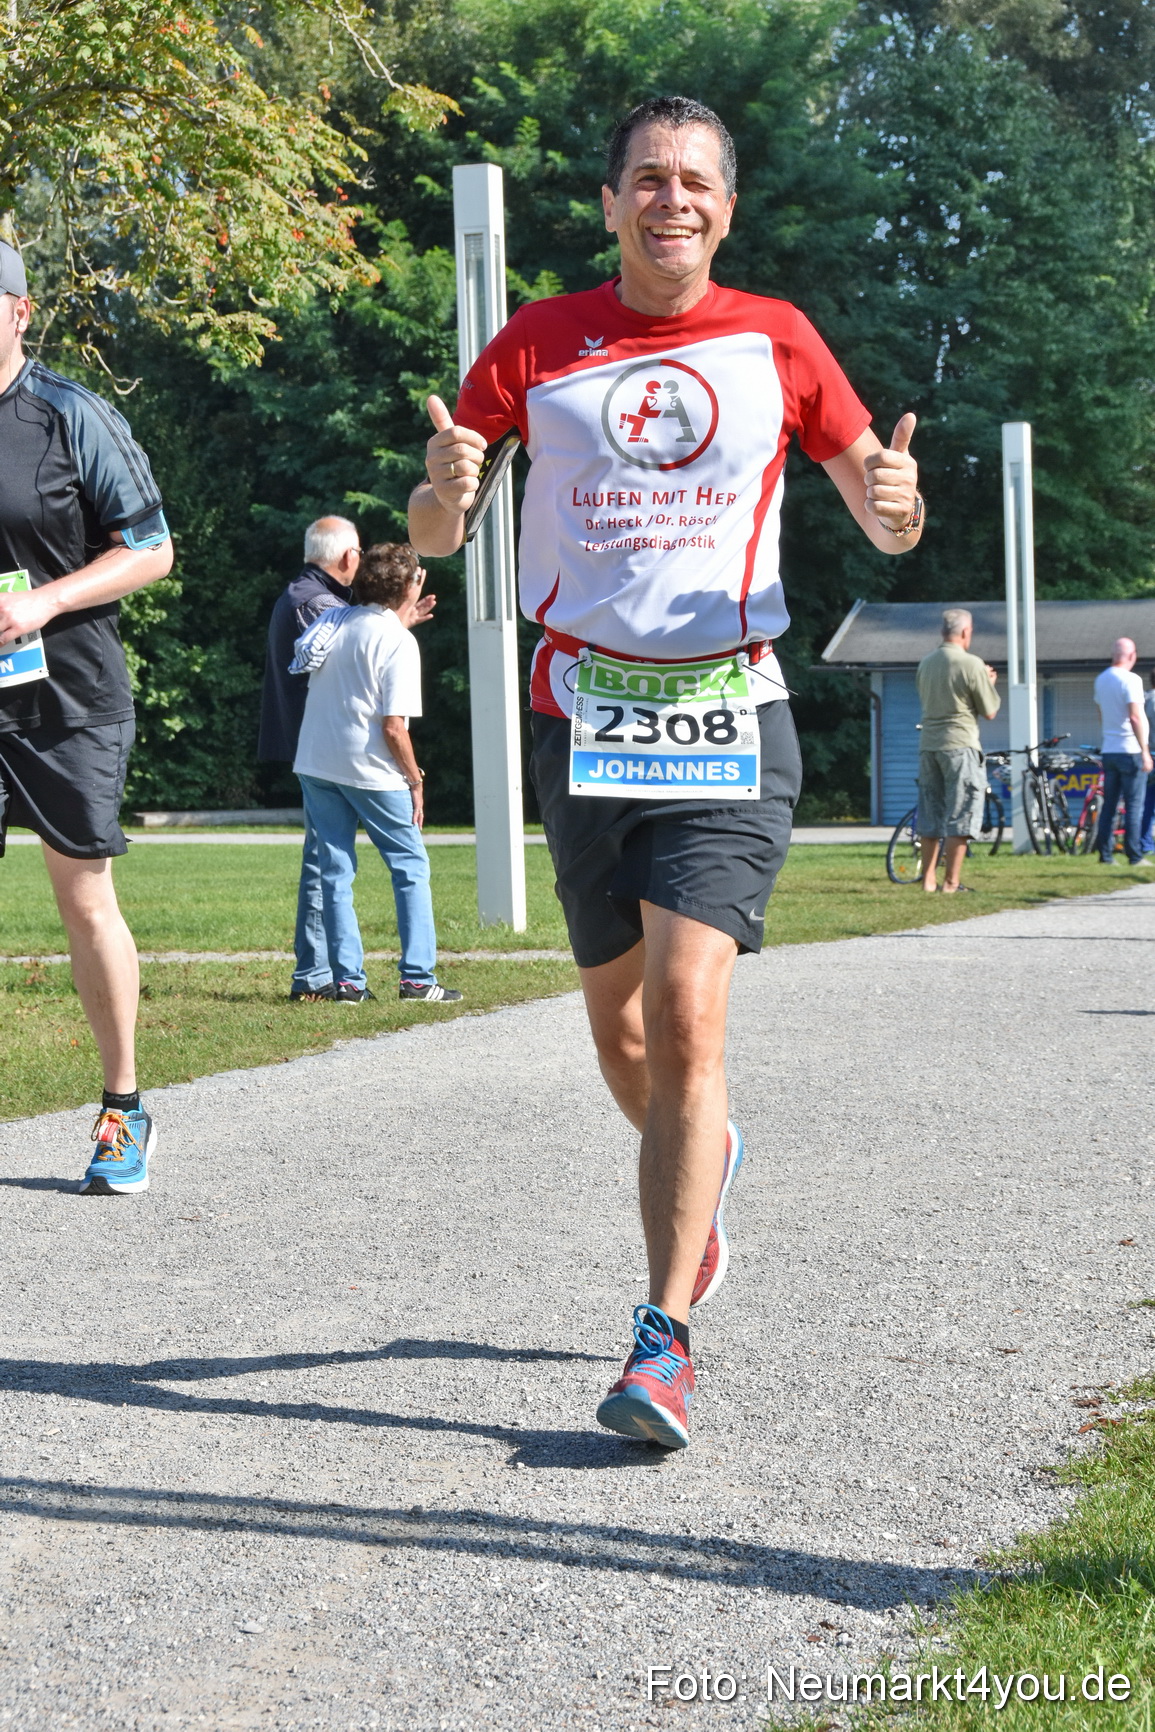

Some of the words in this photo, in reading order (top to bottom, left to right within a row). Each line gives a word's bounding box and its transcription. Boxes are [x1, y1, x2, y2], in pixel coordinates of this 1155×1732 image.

[578, 348, 609, 357] erima
[696, 486, 740, 507] HER
[585, 518, 604, 531] Dr.
[607, 515, 643, 529] Heck
[655, 513, 674, 526] Dr.
[585, 534, 716, 552] Leistungsdiagnstik
[590, 662, 737, 699] BOCK
[594, 705, 739, 746] 2308
[588, 759, 741, 781] JOHANNES
